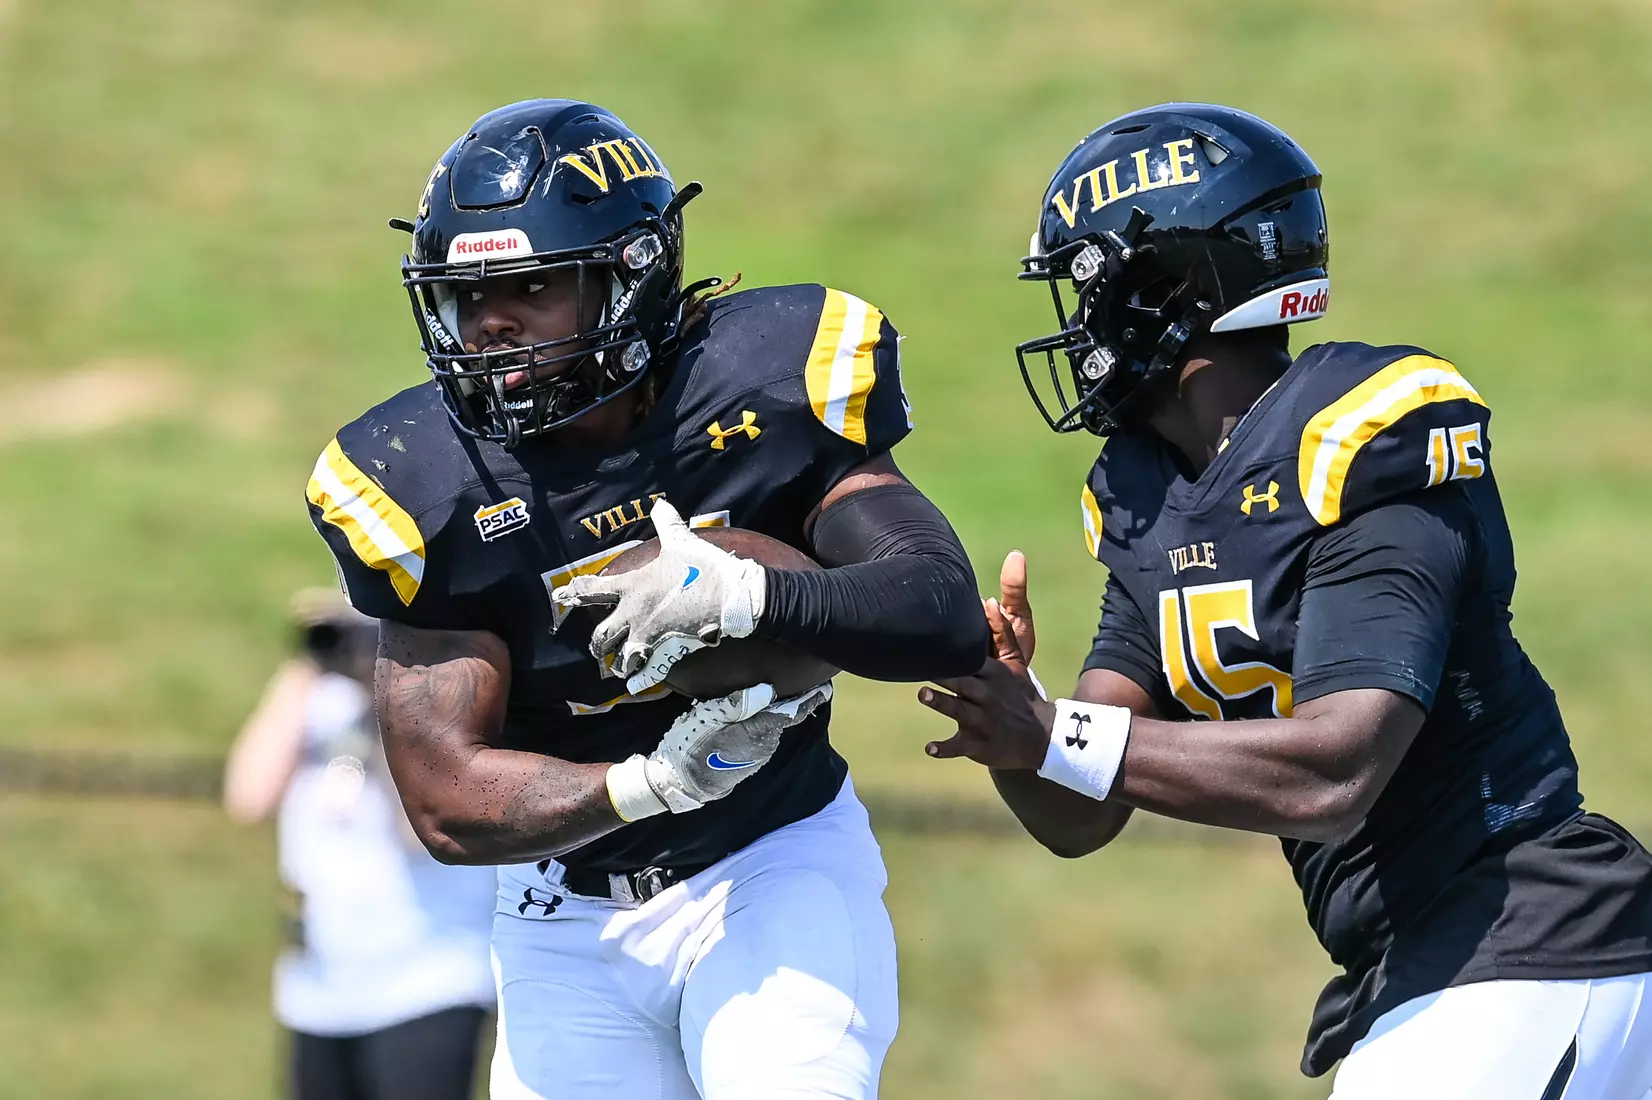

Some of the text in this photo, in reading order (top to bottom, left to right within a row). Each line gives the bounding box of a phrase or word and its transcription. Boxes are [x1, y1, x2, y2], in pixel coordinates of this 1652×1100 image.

[559, 137, 664, 193] VILL
[1051, 138, 1200, 229] VILLE
[456, 238, 517, 254] Riddell
[1280, 288, 1329, 319] Ridd
[1423, 412, 1484, 488] 15
[479, 505, 525, 532] PSAC
[580, 491, 667, 539] VILL
[1168, 542, 1217, 575] VILLE
[1159, 579, 1293, 721] 15
